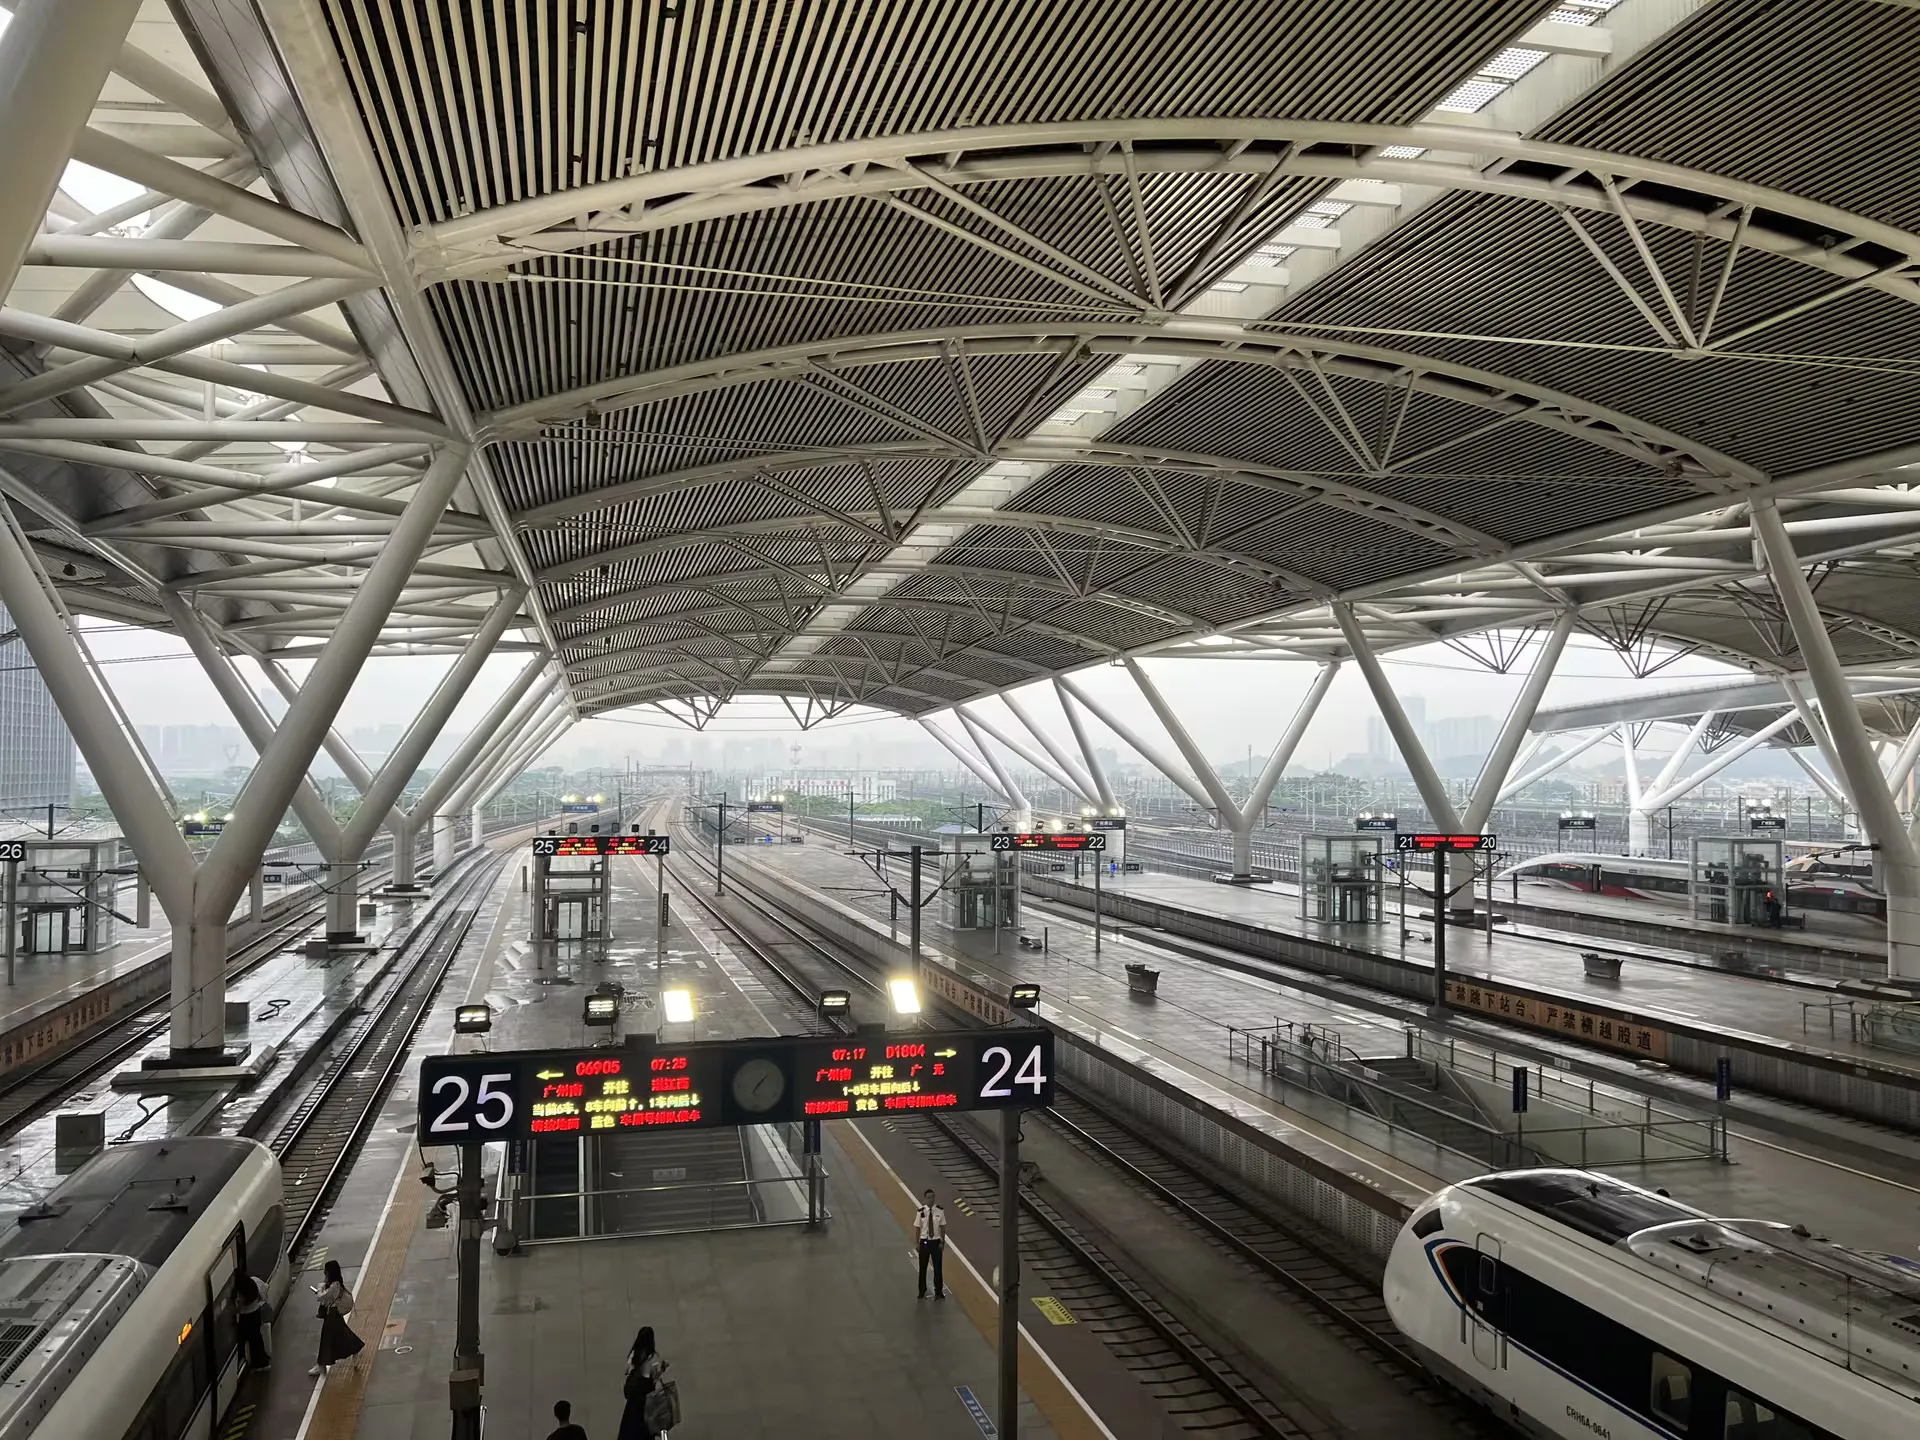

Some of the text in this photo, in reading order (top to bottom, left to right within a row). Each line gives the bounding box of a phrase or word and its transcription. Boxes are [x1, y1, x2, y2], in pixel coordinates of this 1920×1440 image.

[534, 840, 555, 854] 25
[648, 839, 668, 853] 24
[993, 836, 1010, 849] 23
[1088, 836, 1105, 849] 22
[1399, 836, 1413, 848] 21
[1481, 836, 1496, 849] 20
[0, 843, 22, 859] 26
[832, 1047, 866, 1061] 07:17
[576, 1056, 688, 1076] C6905 07:25
[870, 1064, 894, 1079] 开往
[979, 1044, 1048, 1098] 24
[603, 1080, 629, 1095] 开往
[429, 1073, 514, 1133] 25
[855, 1098, 879, 1112] 黄色
